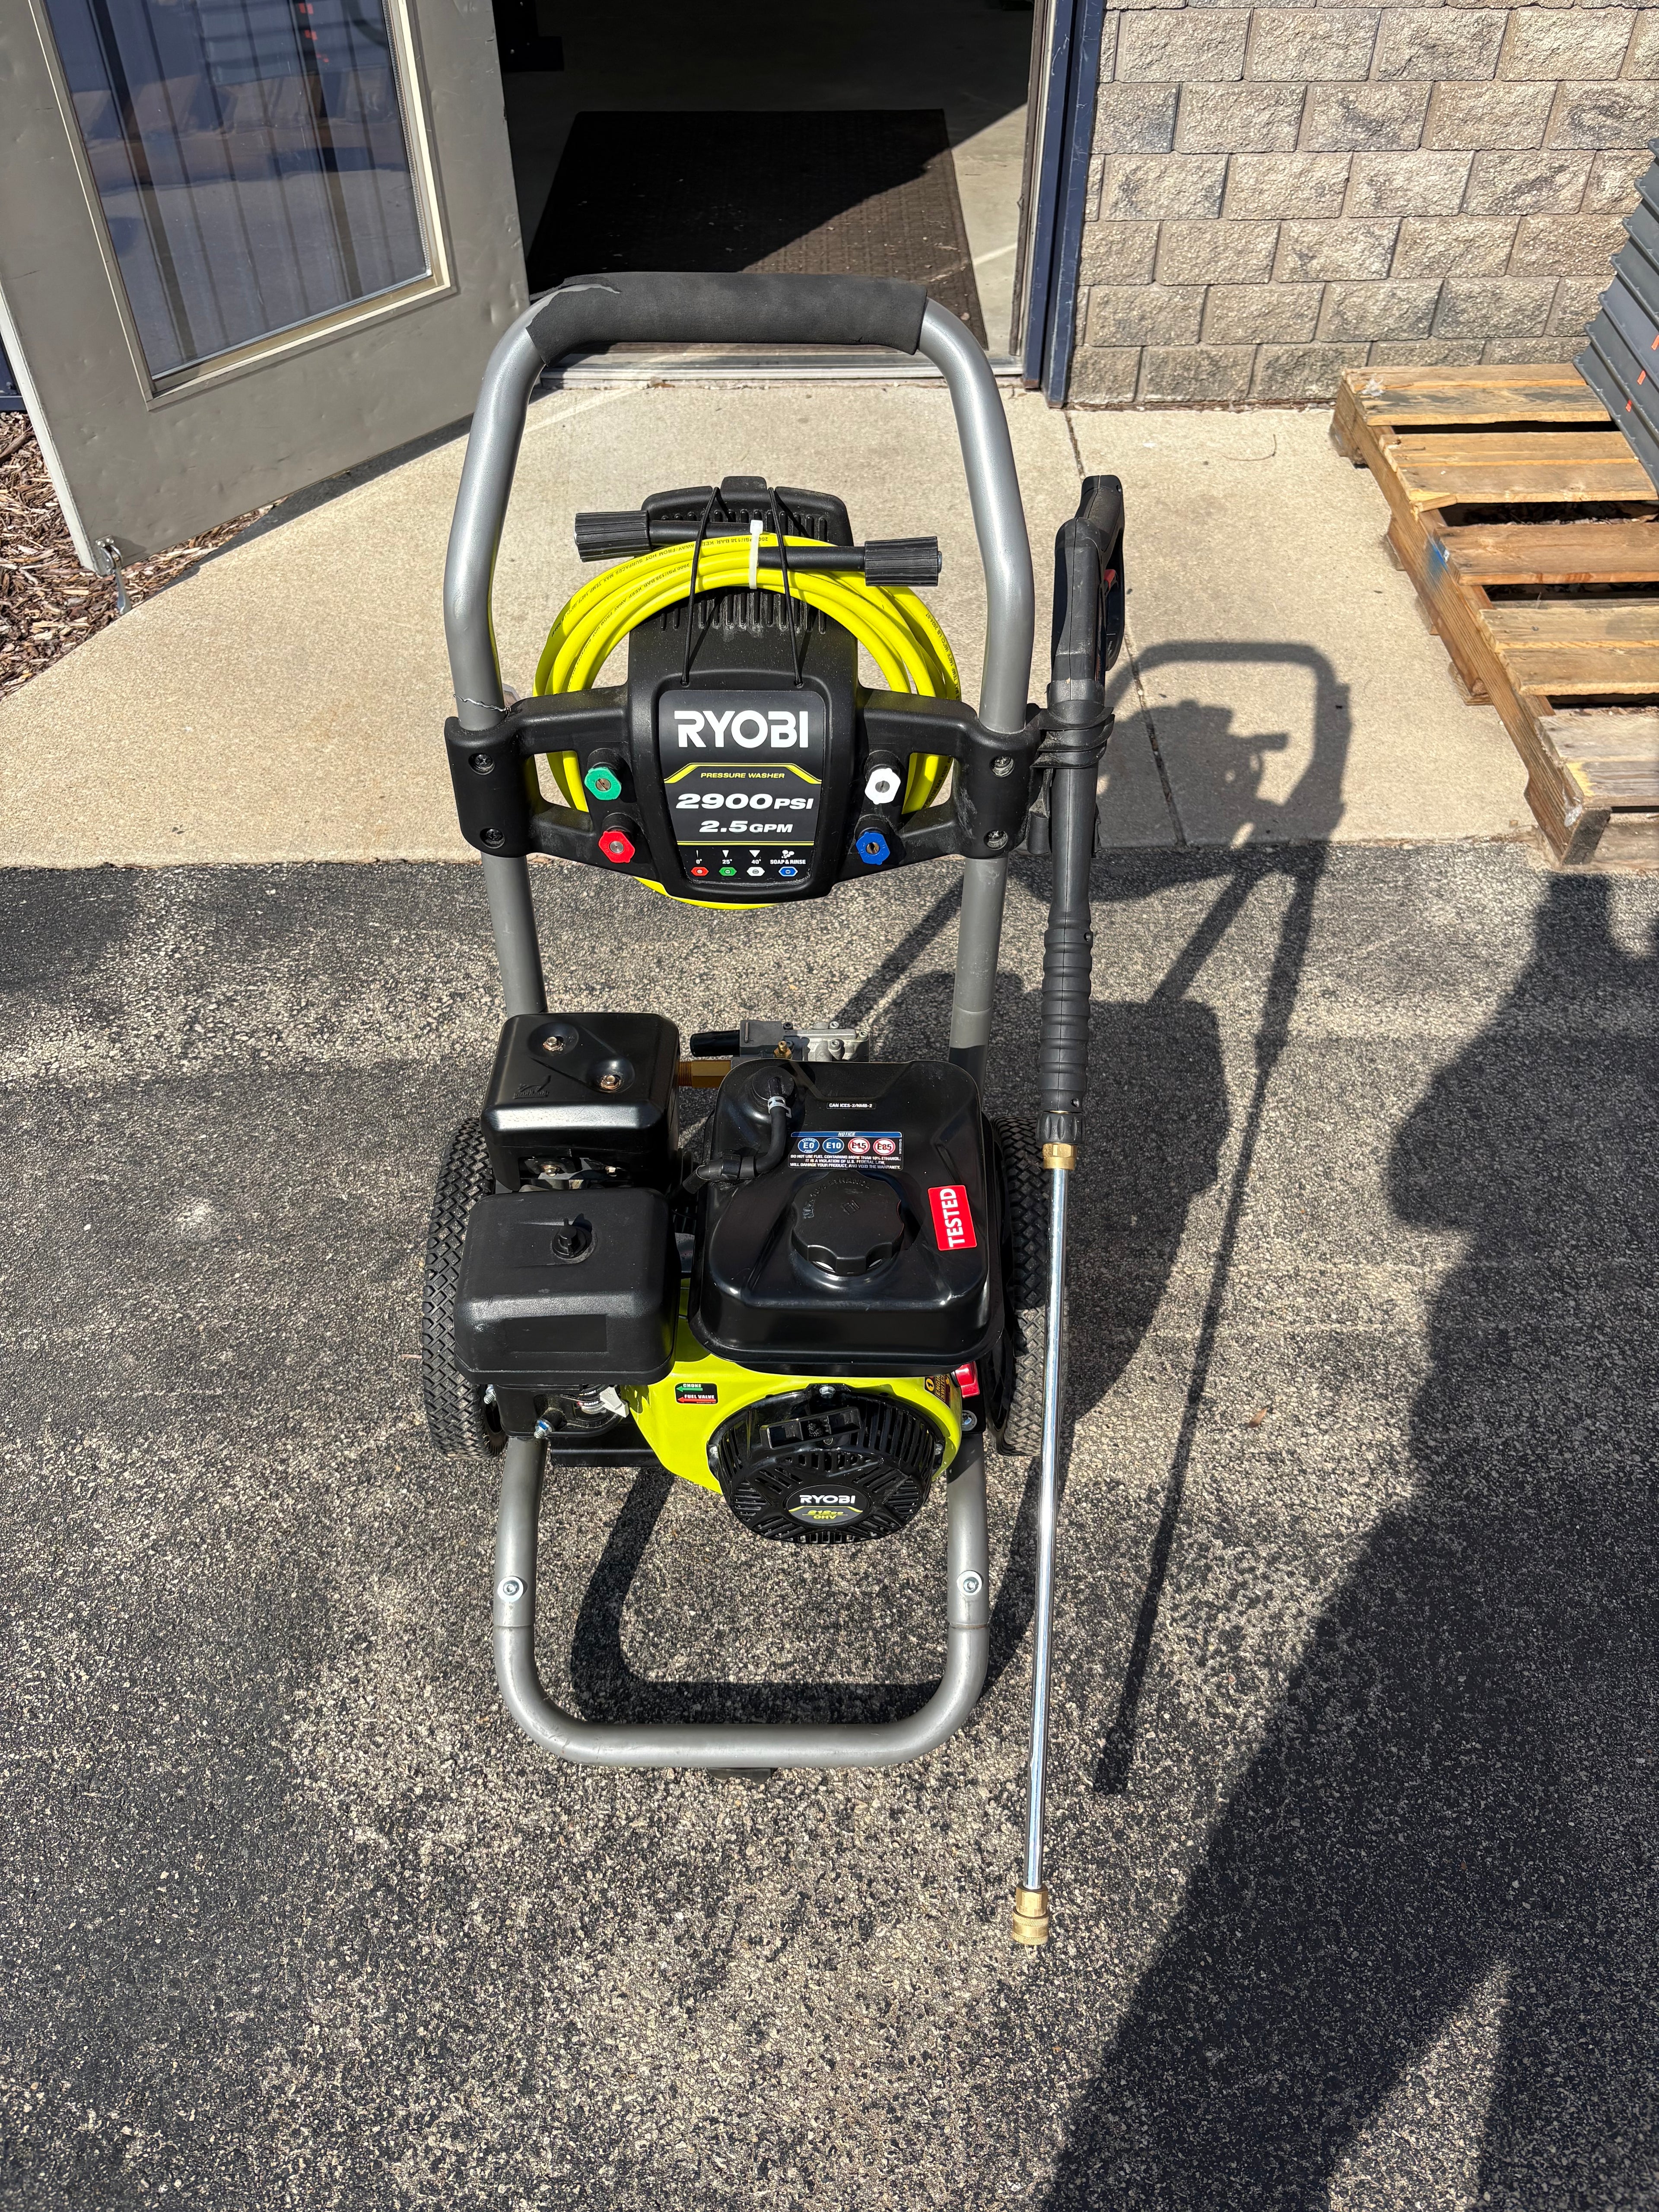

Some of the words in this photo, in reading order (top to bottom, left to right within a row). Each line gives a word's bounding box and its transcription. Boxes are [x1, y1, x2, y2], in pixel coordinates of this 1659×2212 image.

[659, 547, 676, 556] FROM
[616, 559, 643, 575] SURFACES
[603, 572, 614, 583] MAX
[589, 582, 602, 593] TEMP
[613, 598, 627, 612] AWAY
[674, 710, 808, 748] RYOBI
[940, 1188, 965, 1248] TESTED
[799, 1495, 855, 1503] RYOBI
